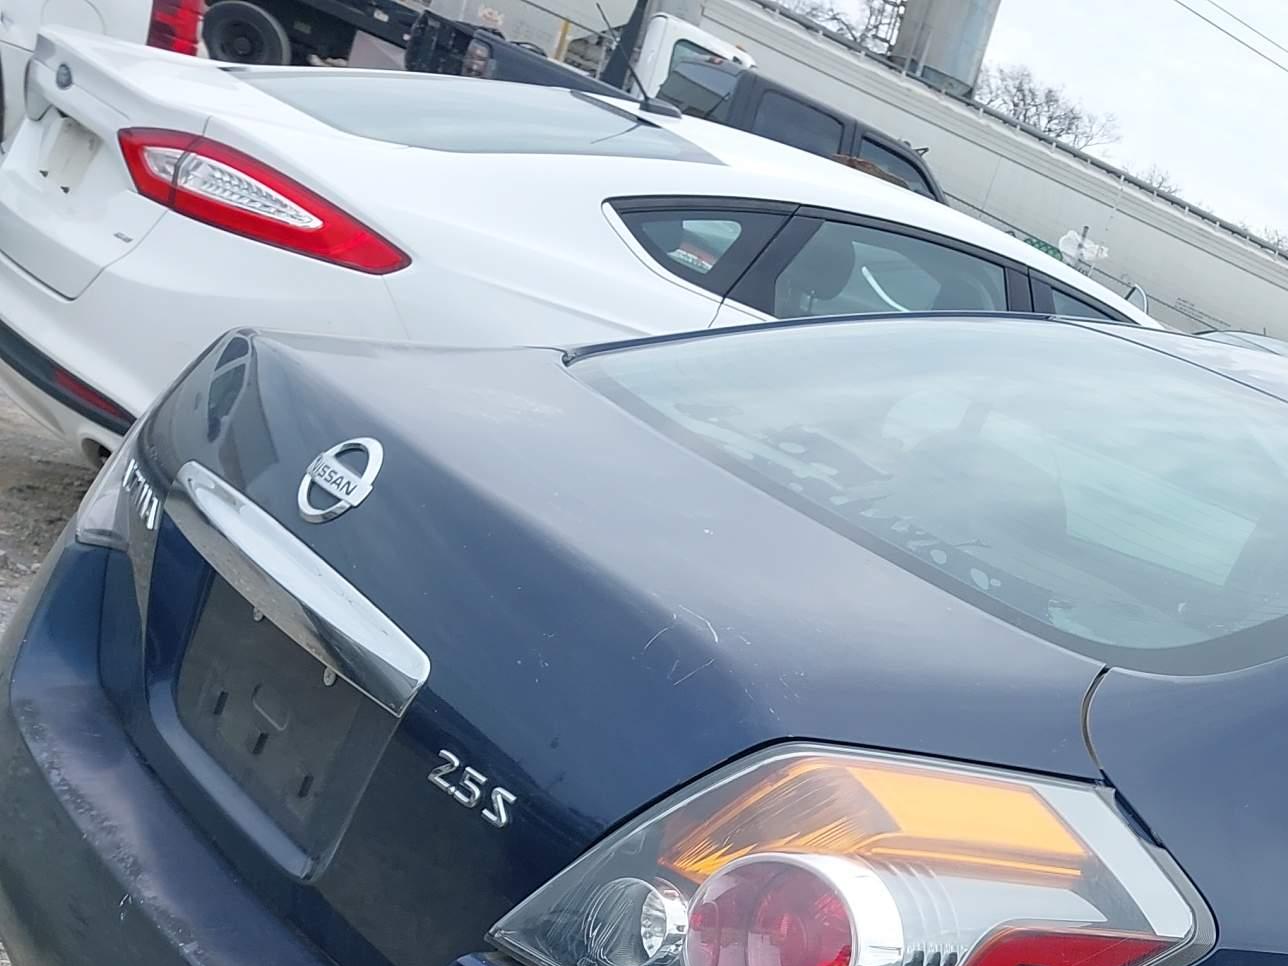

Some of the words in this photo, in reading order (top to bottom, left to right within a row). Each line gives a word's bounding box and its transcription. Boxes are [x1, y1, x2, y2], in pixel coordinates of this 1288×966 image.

[312, 455, 358, 496] NISSAN
[428, 749, 488, 809] 2.5
[481, 786, 517, 828] S
